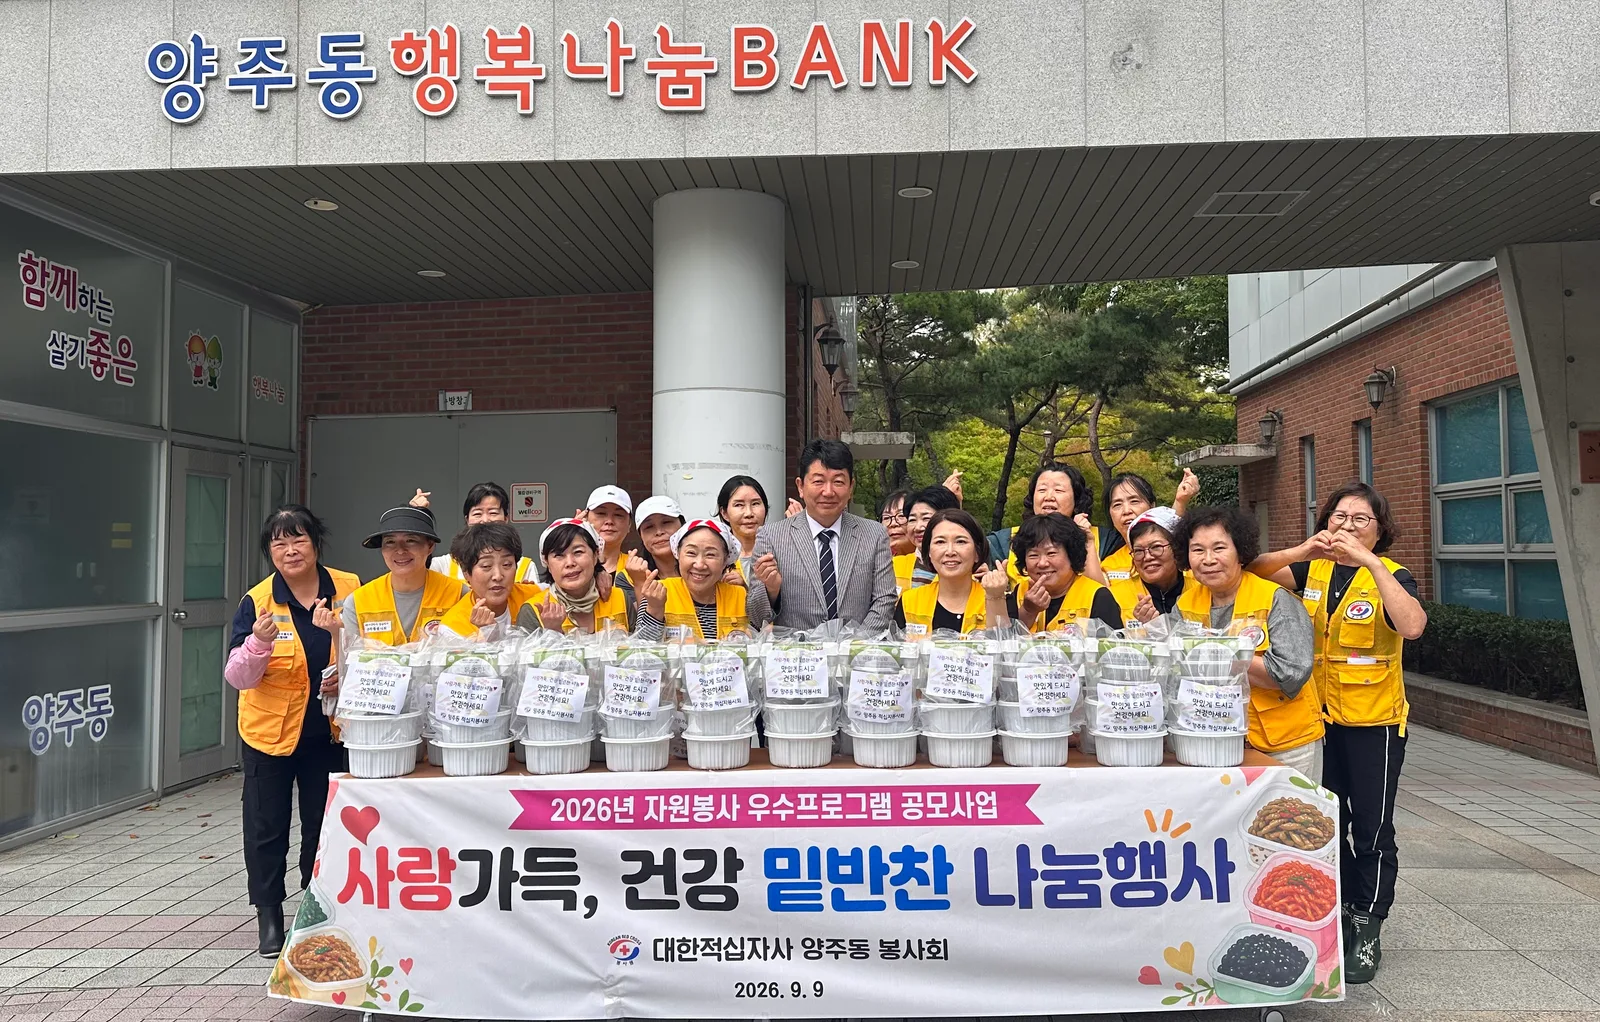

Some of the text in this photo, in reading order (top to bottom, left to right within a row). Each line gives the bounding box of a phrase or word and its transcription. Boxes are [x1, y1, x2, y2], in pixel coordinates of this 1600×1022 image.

[146, 30, 376, 124] 양주동
[19, 249, 114, 326] 함께하는
[252, 376, 286, 405] 행복나눔
[781, 665, 797, 673] 맛있게
[944, 663, 980, 676] 맛있게 드시고
[360, 677, 395, 687] 맛있게 드시고
[613, 682, 631, 692] 맛있게
[699, 675, 733, 687] 맛있게 드시고
[1033, 682, 1053, 690] 맛있게
[450, 689, 487, 701] 맛있게 드시고
[538, 684, 574, 695] 맛있게 드시고
[863, 688, 881, 697] 맛있게
[1111, 701, 1131, 710] 맛있게
[1192, 698, 1233, 709] 맛있게 드시고
[550, 790, 998, 823] 2026년 자원봉사 우수프로그램 공모사업
[337, 838, 1236, 919] 사랑가득, 건강 밑반찬 나눔행사
[652, 937, 949, 962] 대한적십자사 양주동 봉사회
[734, 981, 824, 998] 2026. 9. 9
